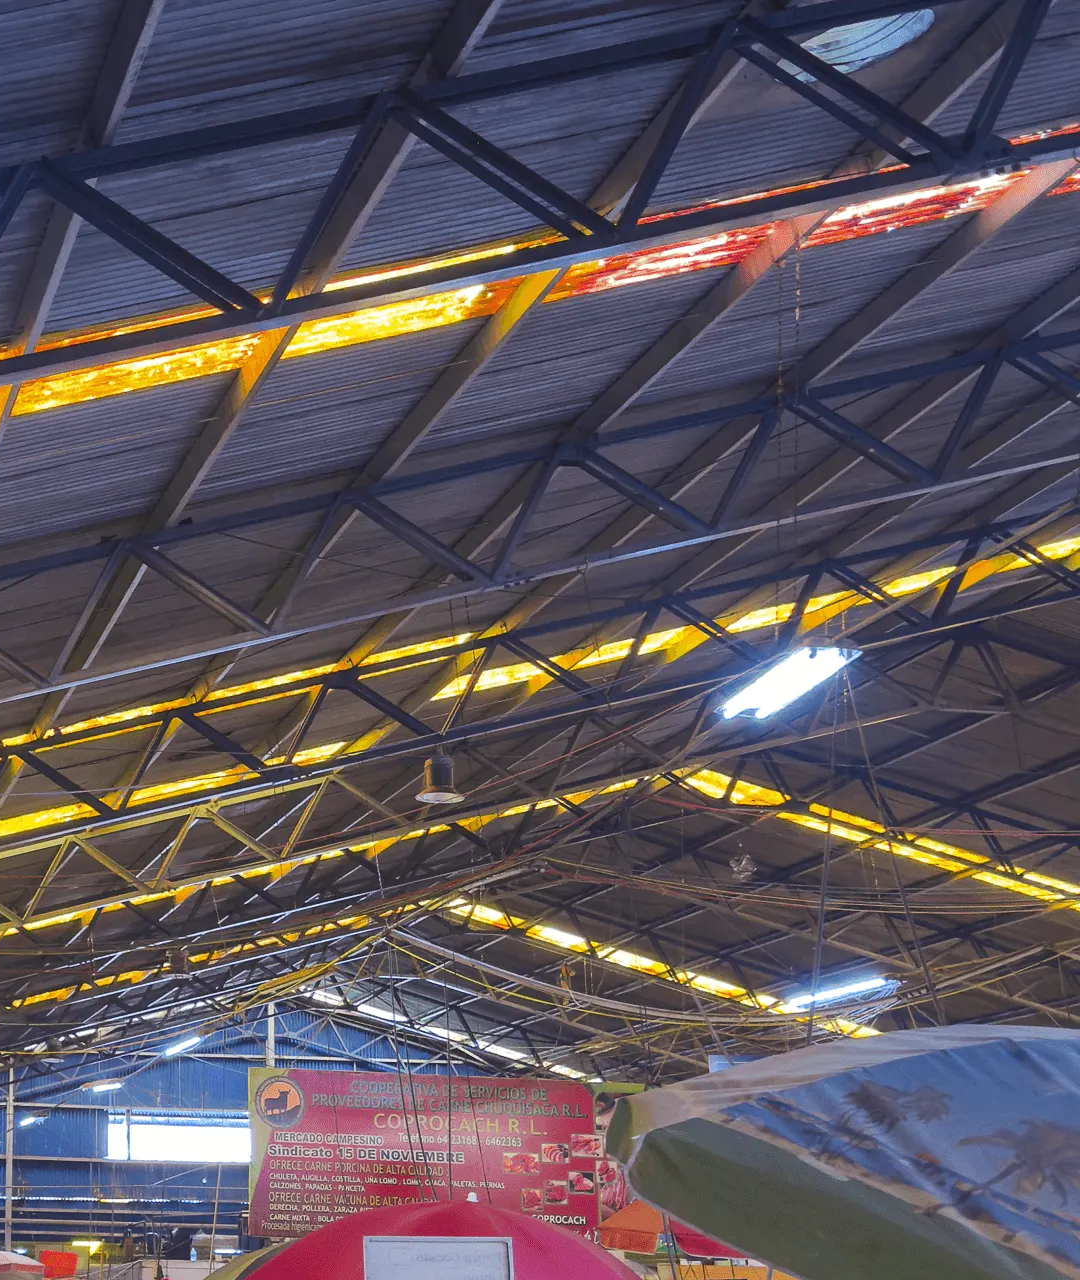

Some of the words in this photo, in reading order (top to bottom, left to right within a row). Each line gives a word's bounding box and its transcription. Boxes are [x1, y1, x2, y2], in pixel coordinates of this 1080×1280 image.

[350, 1080, 439, 1097] COOPERATIVA
[442, 1084, 458, 1098] DE
[464, 1085, 527, 1101] SERVICIOS
[531, 1088, 548, 1101] DE
[311, 1093, 404, 1111] PROVEEDORES
[409, 1098, 425, 1111] DE
[428, 1099, 471, 1114] CARNE
[475, 1100, 559, 1117] CHUQUISACA
[562, 1104, 589, 1118] R.L.
[373, 1113, 500, 1133] COPROCACH
[507, 1118, 548, 1136] R.L.
[275, 1132, 322, 1143] MERCADO
[325, 1134, 383, 1146] CAMPESINO
[485, 1137, 522, 1147] 6462363
[268, 1145, 333, 1158] Sindicato
[337, 1147, 354, 1159] 15
[358, 1148, 376, 1160] DE
[380, 1149, 465, 1164] NOVIEMBRE
[270, 1160, 302, 1171] OFRECE
[304, 1161, 334, 1172] CARNE
[335, 1162, 371, 1174] PORCINA
[373, 1164, 384, 1174] DE
[386, 1164, 406, 1175] ALTA
[408, 1165, 444, 1177] CALIDAD
[269, 1192, 301, 1203] OFRECE
[304, 1193, 334, 1204] CARNE
[334, 1194, 368, 1205] VACUNA
[370, 1195, 381, 1206] DE
[269, 1213, 290, 1221] CARNE
